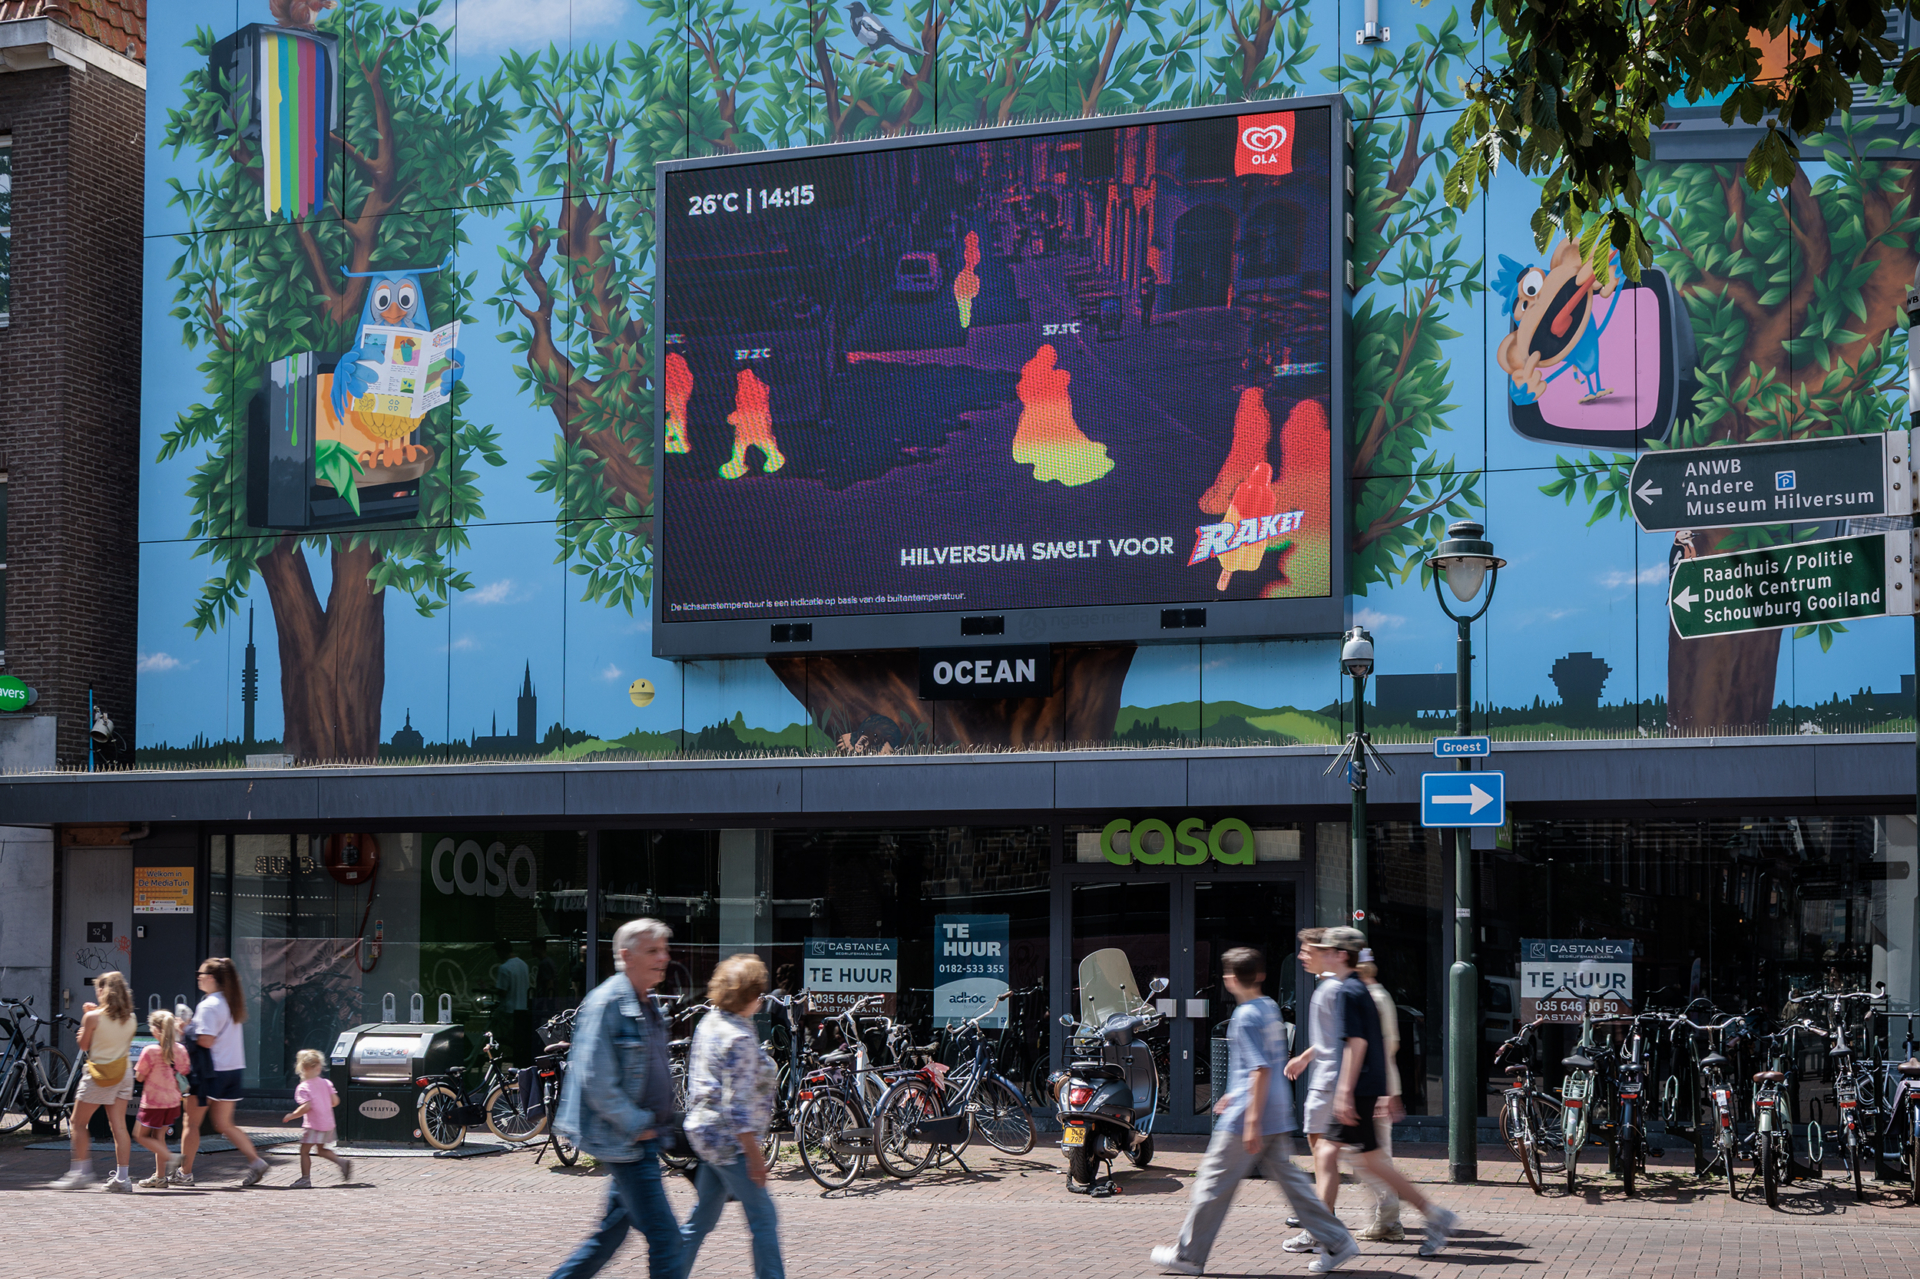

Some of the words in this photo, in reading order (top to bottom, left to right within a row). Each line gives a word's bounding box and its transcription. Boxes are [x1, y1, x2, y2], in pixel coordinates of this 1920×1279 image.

[1251, 153, 1277, 165] OLA
[688, 192, 739, 216] 26°C
[759, 184, 815, 209] 14:15
[1684, 459, 1741, 477] ANWB
[1685, 480, 1754, 496] Andere
[1686, 498, 1767, 516] Museum
[1774, 490, 1874, 510] Hilversum
[1188, 510, 1305, 566] RAKET
[900, 543, 1026, 566] HILVERSUM
[1107, 536, 1174, 557] VOOR
[1703, 560, 1779, 582] Raadhuis
[1796, 550, 1853, 570] Politie
[1704, 583, 1753, 603] Dudok
[1759, 576, 1832, 596] Centrum
[671, 603, 682, 612] De
[766, 599, 773, 608] is
[790, 597, 823, 607] indicatie
[825, 598, 836, 606] op
[837, 596, 858, 605] basis
[859, 596, 874, 604] van
[875, 594, 886, 603] de
[887, 593, 966, 603] buitentemperatuur.
[1704, 600, 1801, 624] Schouwburg
[1807, 588, 1880, 610] Gooiland
[932, 658, 1036, 685] OCEAN
[1443, 742, 1481, 753] Groest
[1099, 817, 1256, 866] casa
[146, 870, 175, 878] Welkom
[431, 837, 537, 899] casa
[138, 879, 149, 887] De
[150, 879, 190, 887] MediaTuin
[92, 928, 101, 936] 52
[101, 934, 106, 942] b
[942, 923, 970, 939] TE
[828, 942, 890, 951] CASTANEA
[943, 941, 1001, 957] HUUR
[1549, 944, 1624, 954] CASTANEA
[809, 967, 833, 982] TE
[839, 967, 892, 983] HUUR
[938, 964, 984, 973] 0182-533
[986, 964, 1005, 973] 355
[1527, 971, 1555, 988] TE
[1563, 972, 1627, 989] HUUR
[816, 993, 835, 1004] 035
[837, 994, 855, 1004] 646
[949, 991, 986, 1004] adhoc
[1535, 1000, 1558, 1011] 035
[1560, 1001, 1583, 1012] 646
[1603, 1002, 1618, 1012] 50
